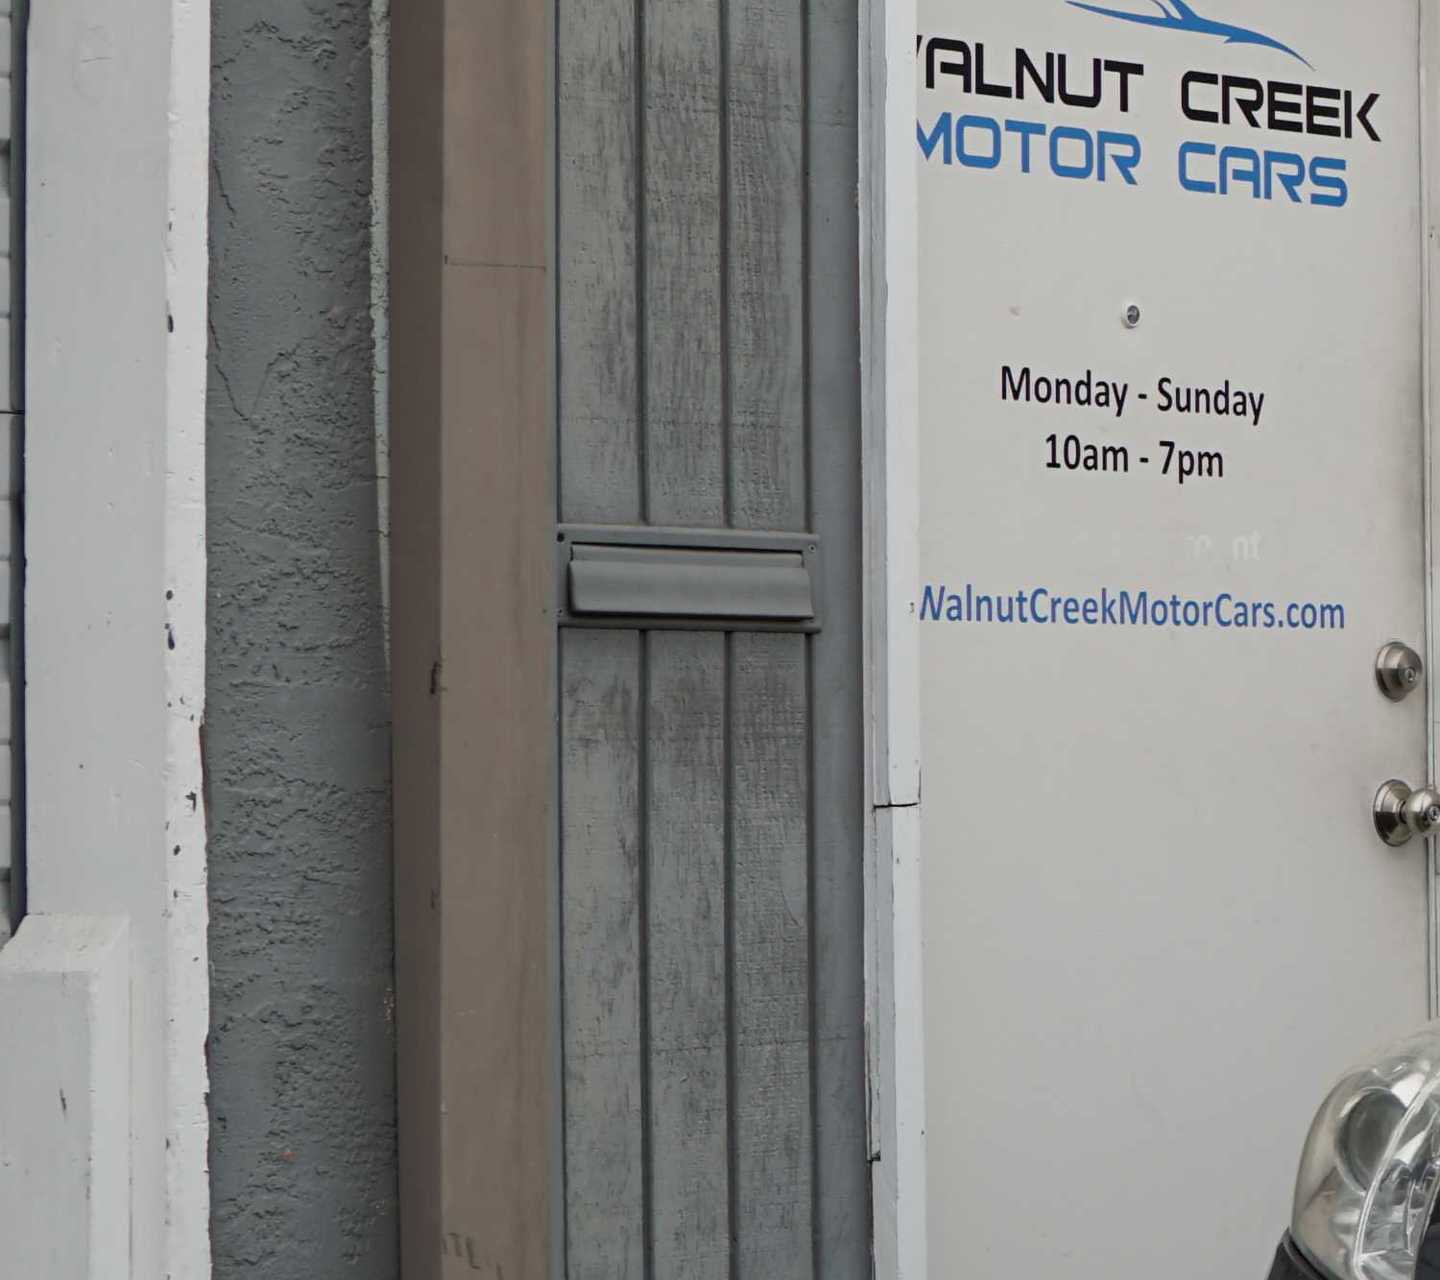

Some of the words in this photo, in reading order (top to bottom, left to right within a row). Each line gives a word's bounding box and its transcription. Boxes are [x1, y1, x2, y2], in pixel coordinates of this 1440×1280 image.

[916, 34, 1144, 112] ALNUT
[1180, 70, 1382, 143] CREEK
[1178, 141, 1349, 208] CARS
[1000, 364, 1129, 418] Monday
[1156, 375, 1265, 427] Sunday
[1044, 433, 1130, 474] 10am
[1158, 441, 1225, 483] 7pm
[919, 583, 1345, 631] WalnutCreekMotorCars.com
